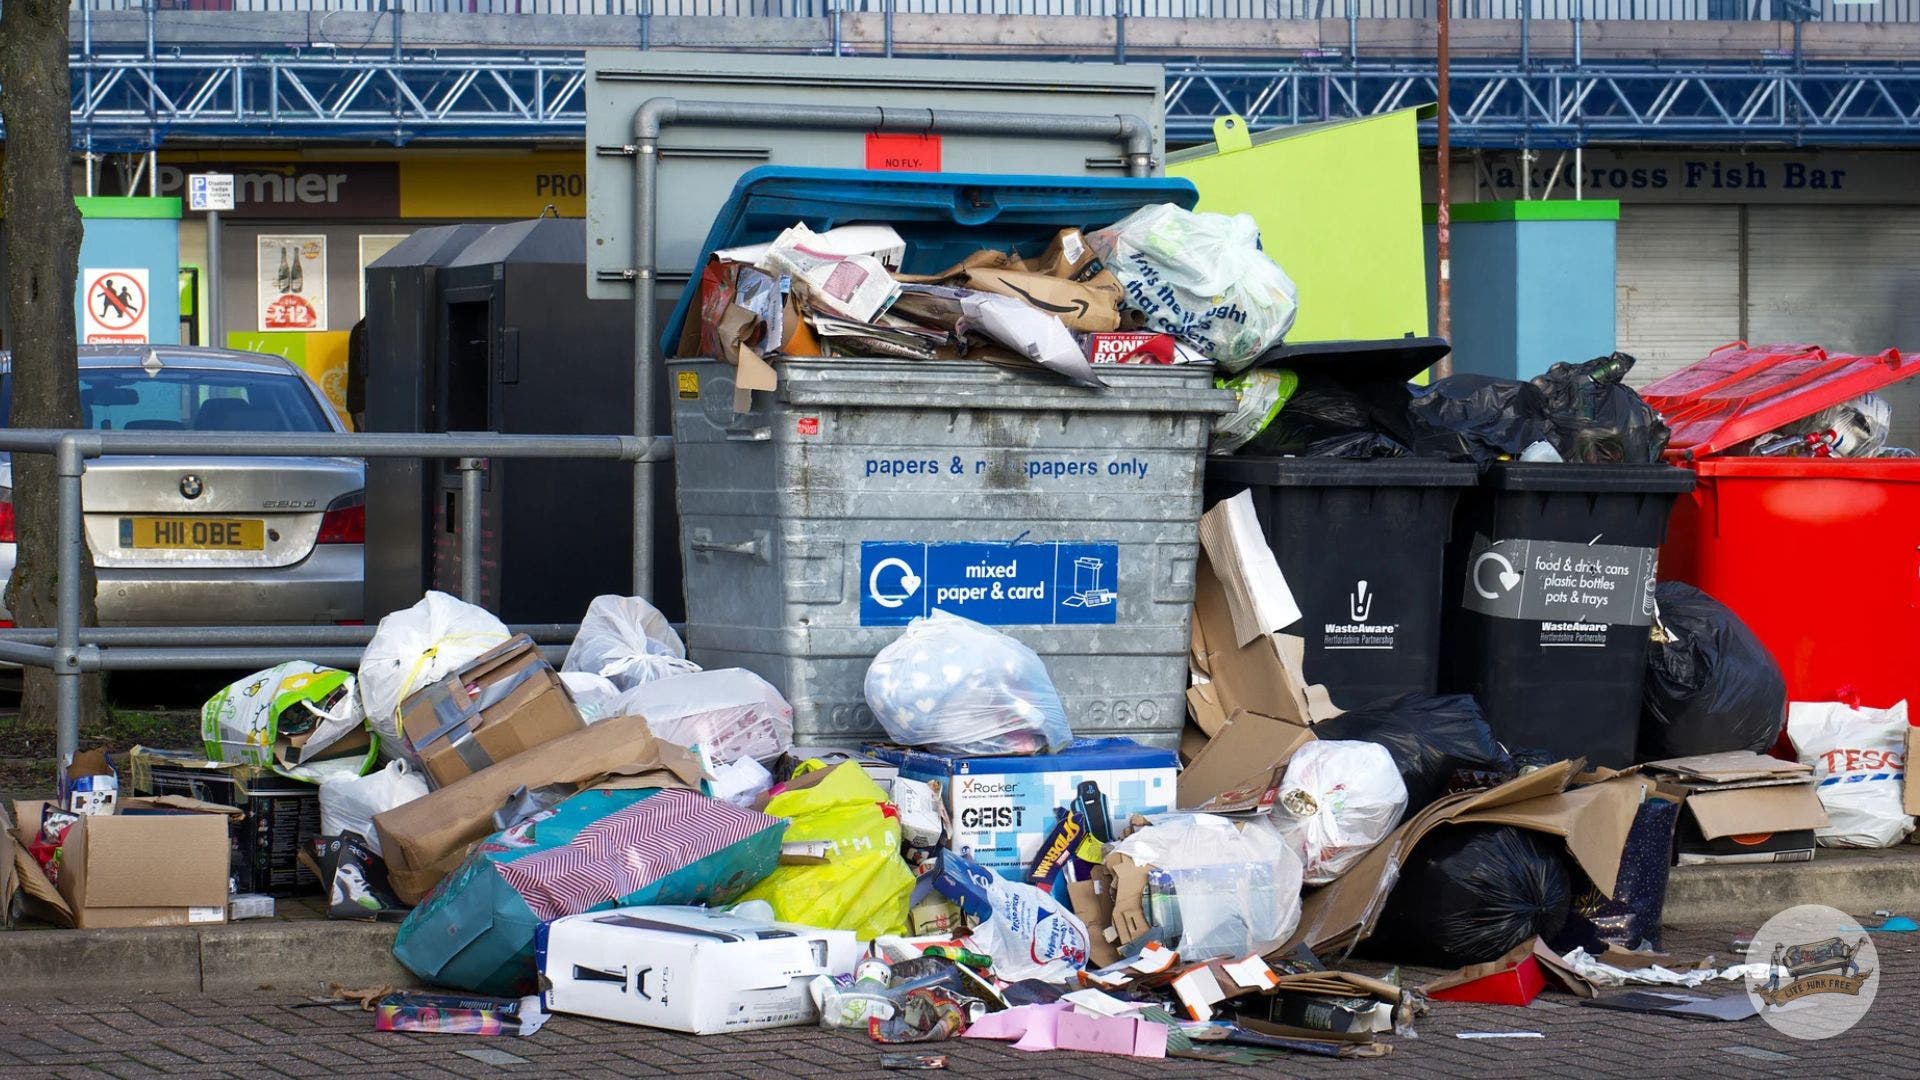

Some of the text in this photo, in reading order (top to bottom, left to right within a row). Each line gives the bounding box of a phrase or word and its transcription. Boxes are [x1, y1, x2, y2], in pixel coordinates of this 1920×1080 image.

[885, 158, 900, 168] NO
[158, 165, 348, 203] Pmier
[1685, 161, 1767, 189] Fish
[1783, 162, 1847, 190] Bar
[1126, 279, 1161, 316] that
[1156, 281, 1182, 316] the
[273, 304, 308, 324] £12
[865, 459, 940, 477] papers
[949, 455, 965, 474] &
[1107, 457, 1149, 479] only
[965, 559, 1018, 579] mixed
[1535, 556, 1562, 571] food
[1563, 556, 1572, 572] &
[1605, 565, 1630, 576] cans
[937, 580, 1045, 605] paper & card
[1543, 573, 1615, 590] plastic bottles
[1545, 590, 1609, 609] pots & trays
[1361, 634, 1394, 647] Partnership
[1087, 699, 1161, 726] 660
[961, 806, 1026, 828] GEIST
